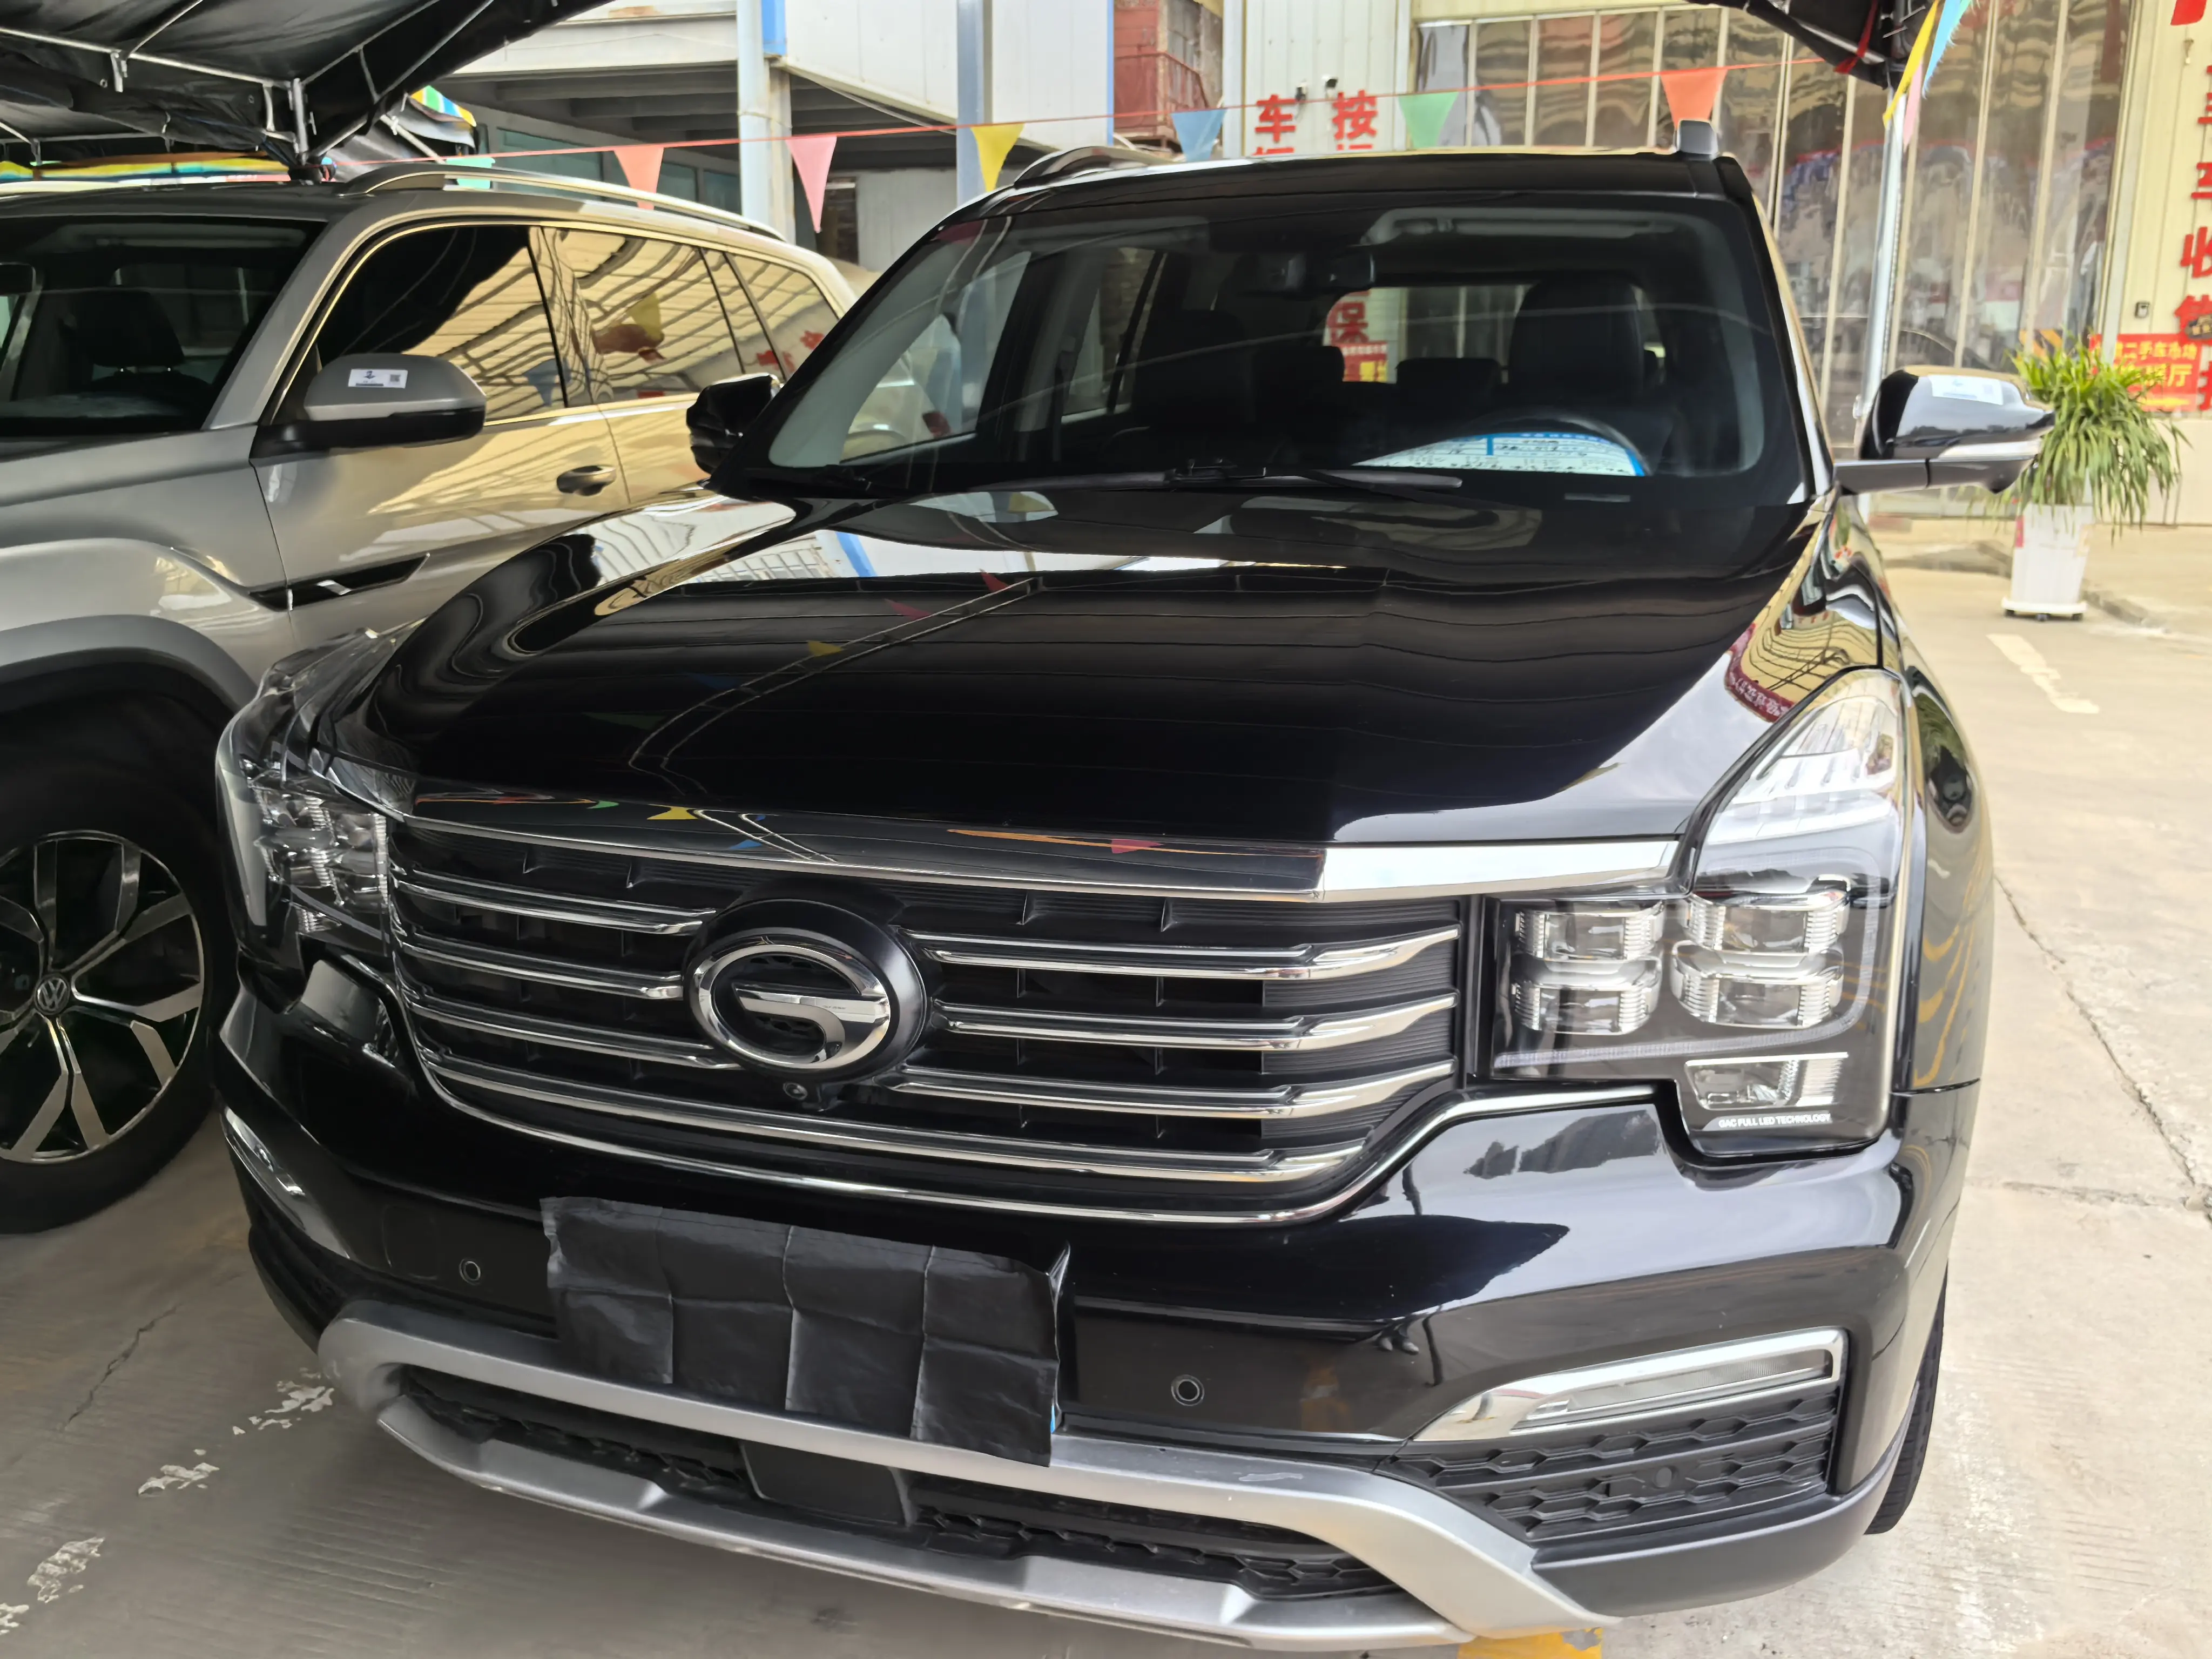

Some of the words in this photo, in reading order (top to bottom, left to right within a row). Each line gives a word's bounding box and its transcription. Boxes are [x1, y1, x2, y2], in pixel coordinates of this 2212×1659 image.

[1738, 1117, 1758, 1127] FULL
[1759, 1116, 1776, 1126] LED
[1776, 1113, 1831, 1125] TECHNOLOGY
